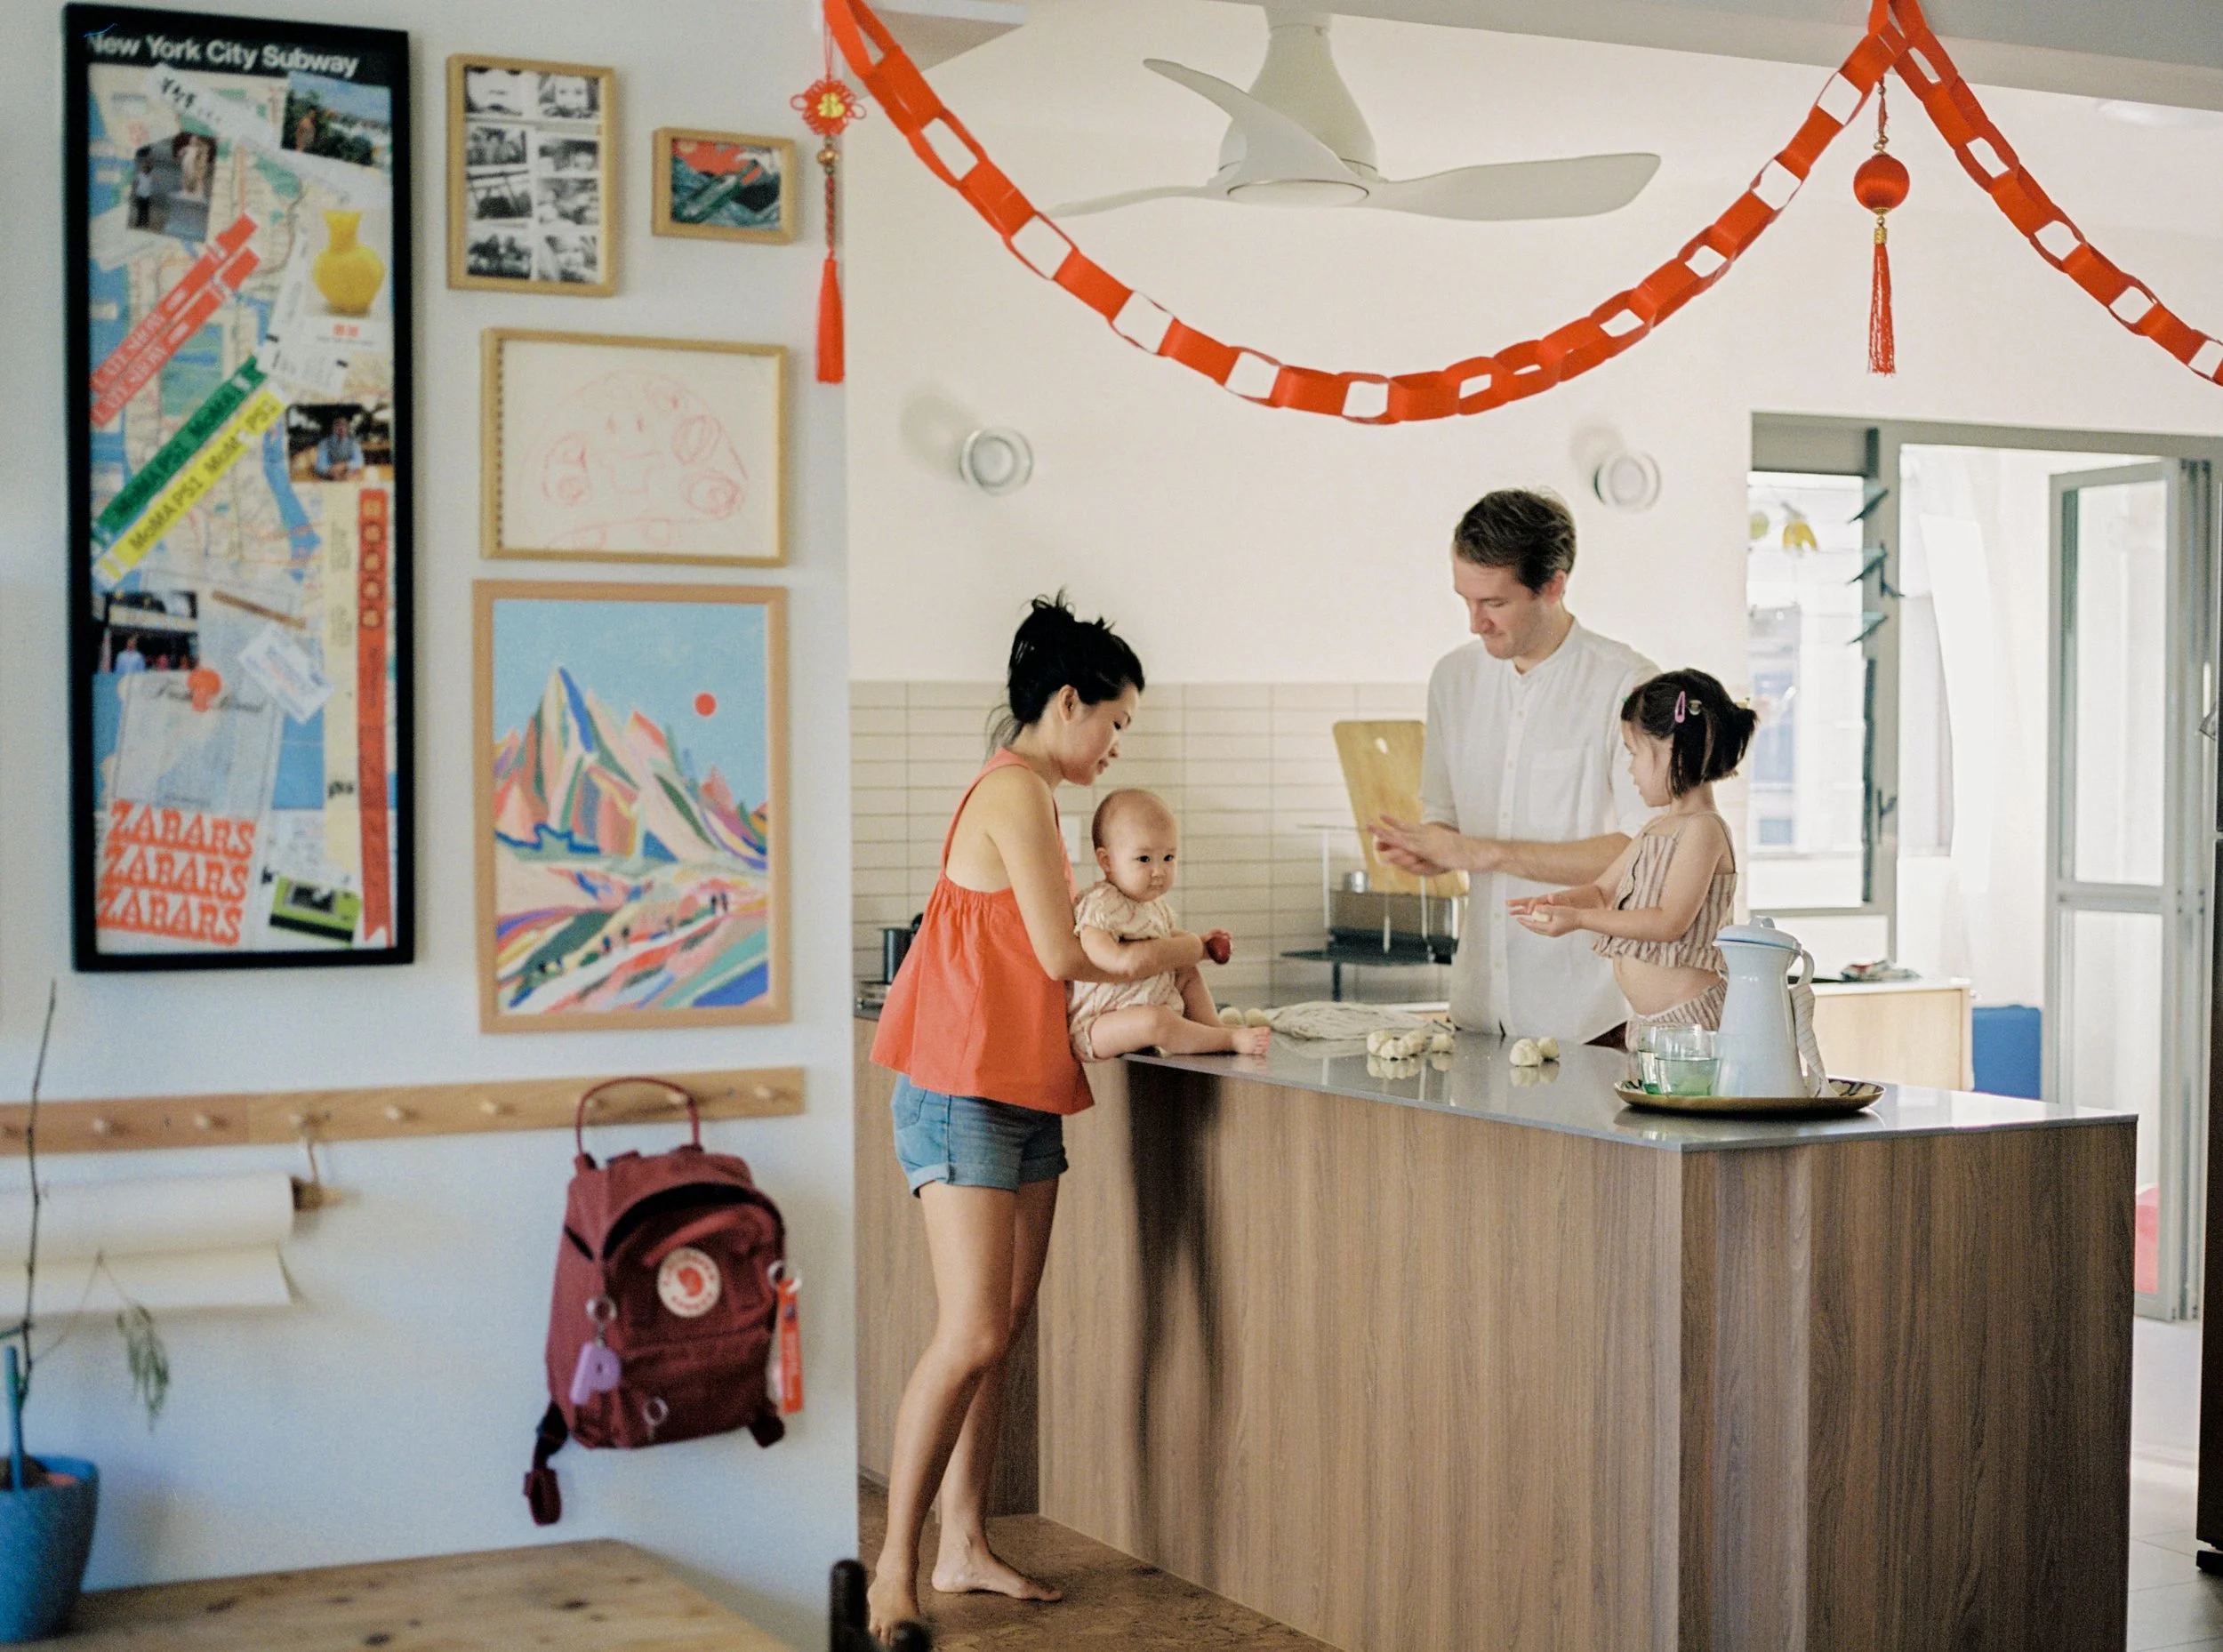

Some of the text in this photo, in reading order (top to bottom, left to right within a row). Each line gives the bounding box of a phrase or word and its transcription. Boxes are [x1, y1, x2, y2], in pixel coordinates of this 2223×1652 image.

[88, 34, 358, 77] New York City Subway
[128, 397, 279, 550] MoMA PS1 MoM PS1
[108, 799, 255, 860] ZABARS
[102, 844, 249, 904] ZABARS
[94, 886, 244, 947] ZABARS
